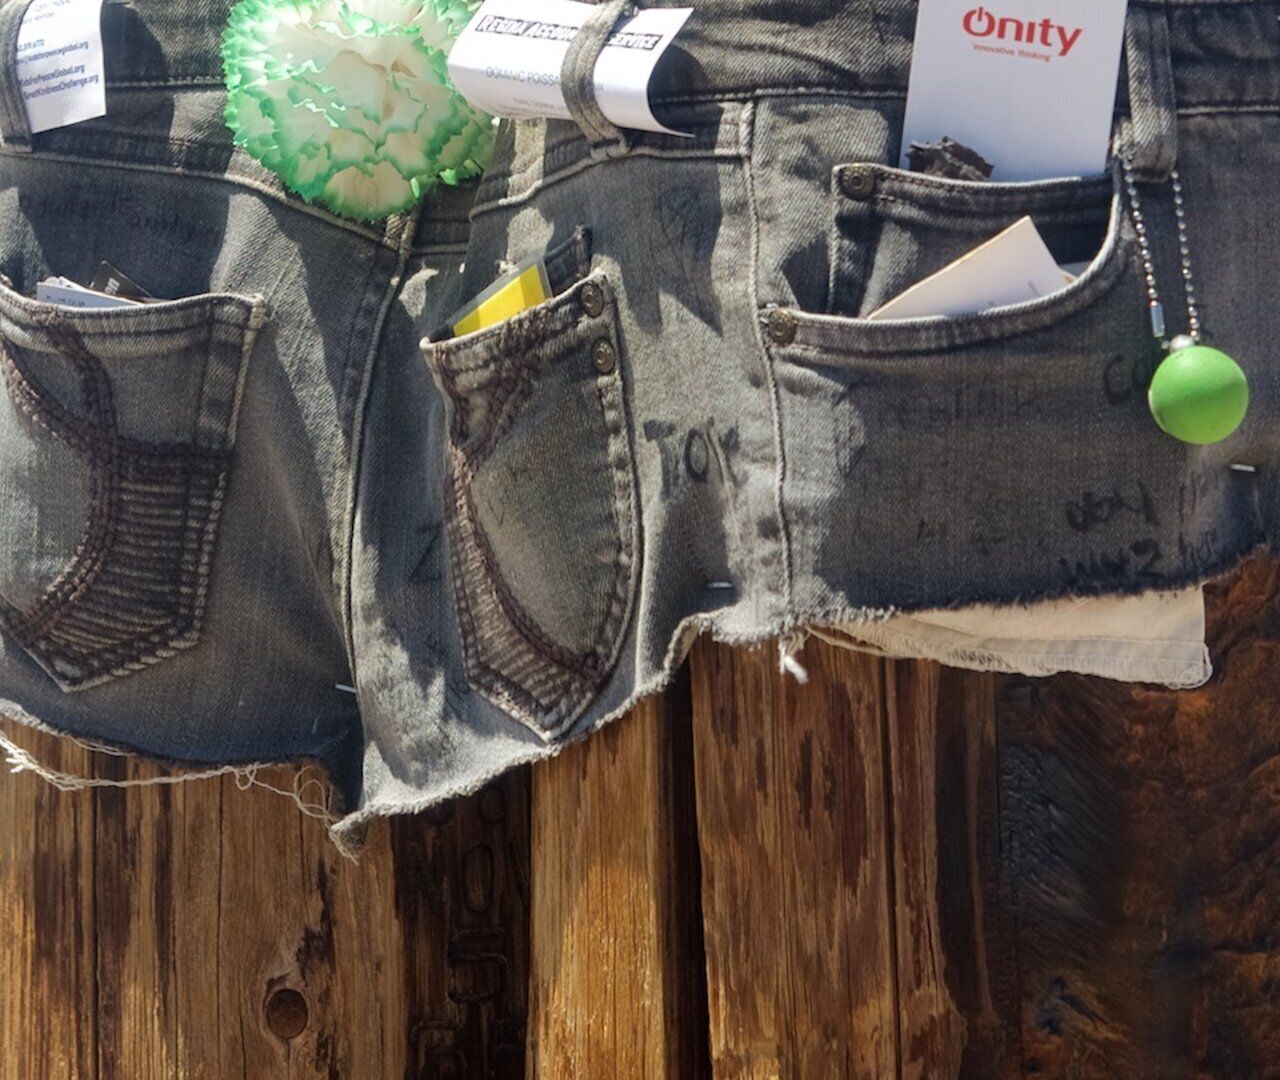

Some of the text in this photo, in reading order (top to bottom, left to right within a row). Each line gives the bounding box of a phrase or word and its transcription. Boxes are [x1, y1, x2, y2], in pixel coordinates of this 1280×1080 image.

[478, 14, 528, 36] REGINA
[525, 21, 580, 41] ACCOUN
[962, 7, 1083, 57] Onity
[485, 66, 526, 82] DOMINIC
